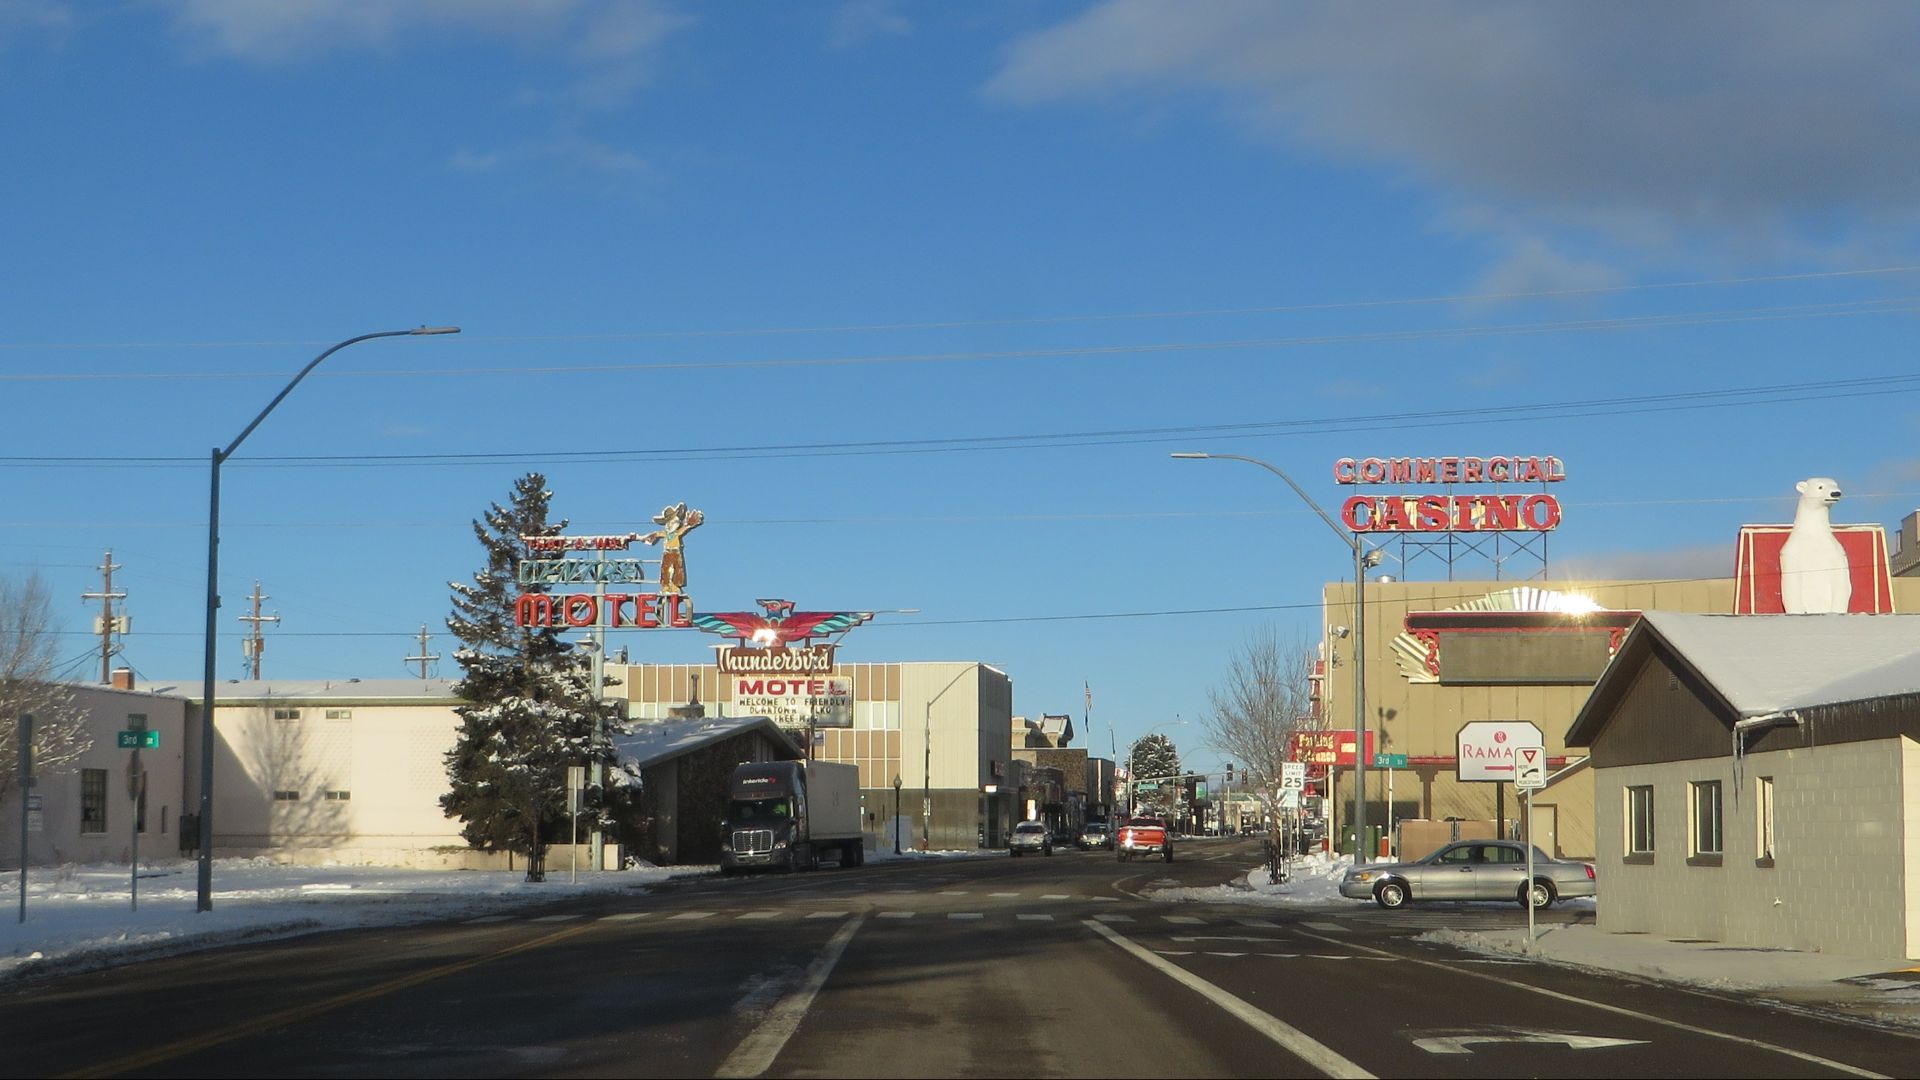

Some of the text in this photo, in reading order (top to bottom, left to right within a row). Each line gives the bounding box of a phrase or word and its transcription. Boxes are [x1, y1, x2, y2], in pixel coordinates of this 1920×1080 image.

[1334, 457, 1566, 483] COMMERCIAL
[1341, 494, 1562, 531] CASINO
[515, 593, 690, 627] MOTEL
[718, 647, 831, 672] Thunderbird
[739, 680, 846, 695] MOTEL
[740, 697, 778, 706] WELCOME
[786, 697, 796, 706] TO
[1463, 744, 1514, 759] RAMA
[1377, 756, 1390, 765] 3rd
[1284, 777, 1302, 788] 25
